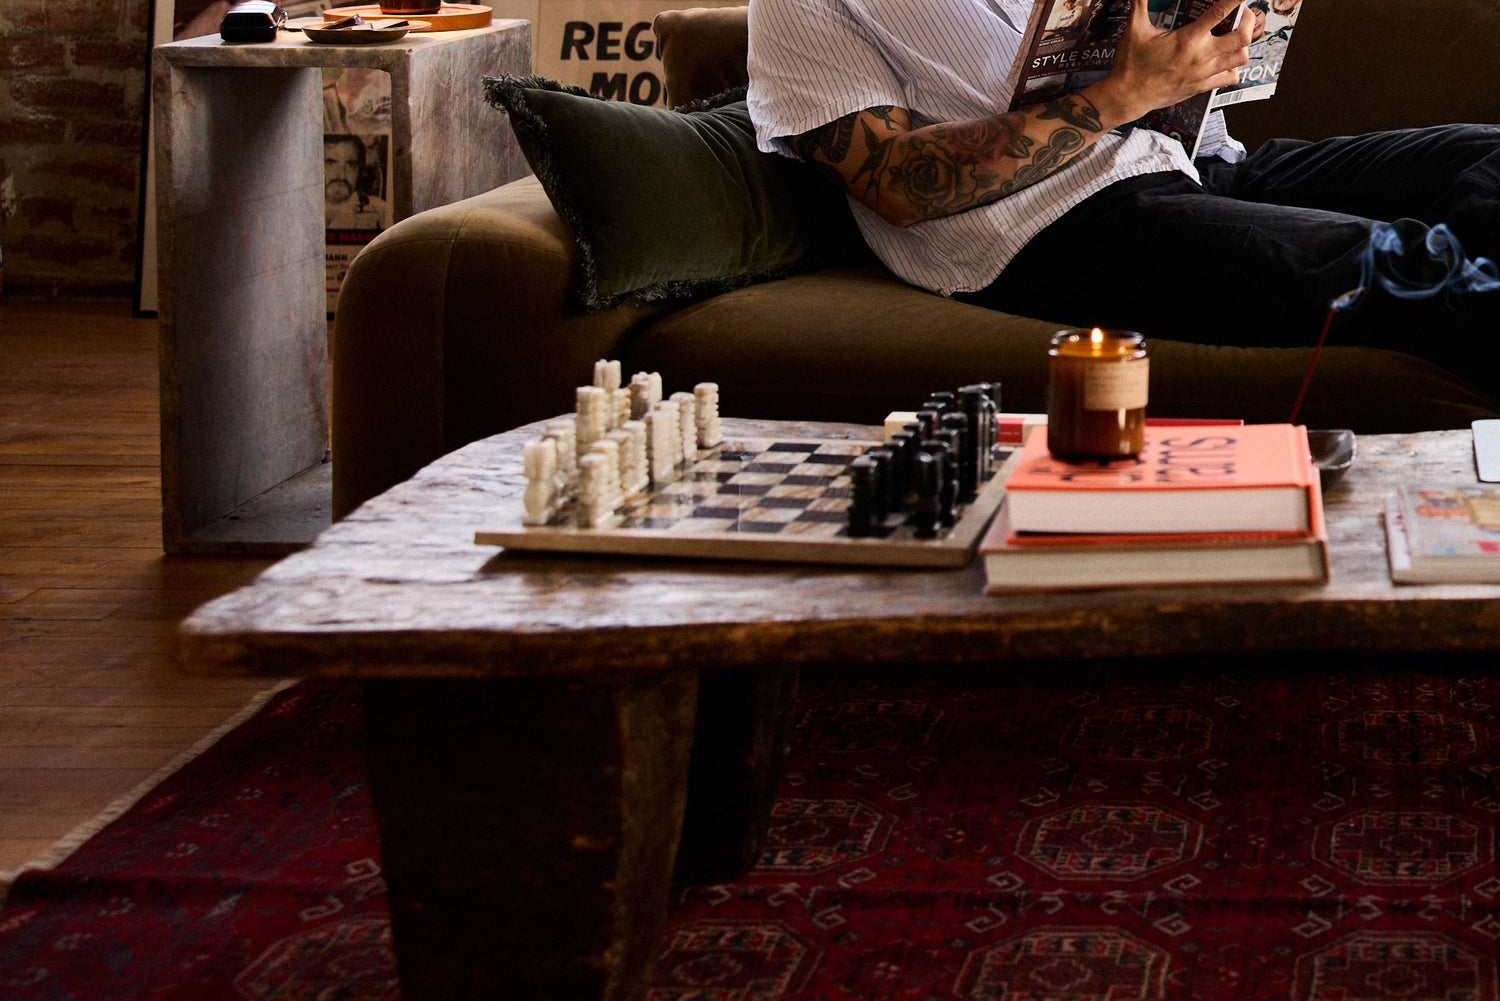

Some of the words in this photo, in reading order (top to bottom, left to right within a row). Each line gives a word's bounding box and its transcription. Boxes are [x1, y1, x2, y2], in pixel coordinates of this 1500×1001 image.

[560, 21, 662, 61] REG
[1032, 50, 1079, 69] STYLE
[589, 71, 667, 107] MO
